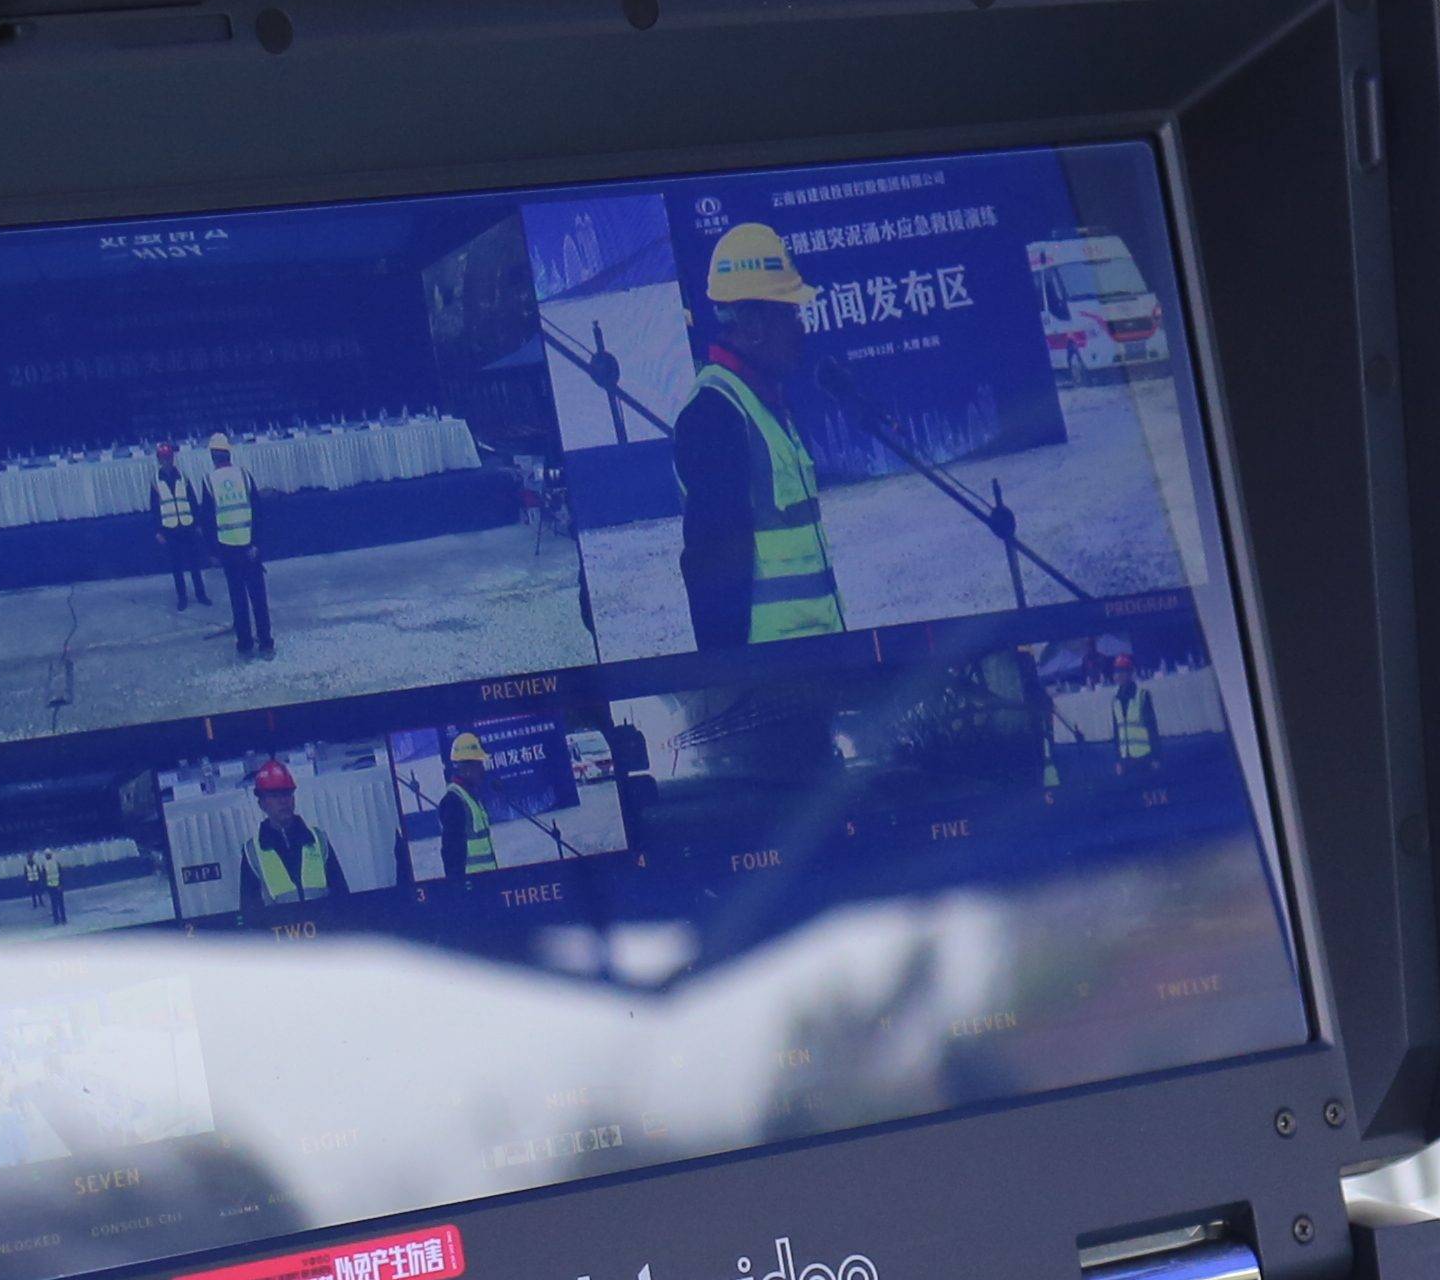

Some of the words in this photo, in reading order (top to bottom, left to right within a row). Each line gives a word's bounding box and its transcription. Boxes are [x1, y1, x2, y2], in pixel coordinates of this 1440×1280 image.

[797, 264, 974, 335] 新闻发布区
[1105, 596, 1178, 617] PROGRAM
[481, 676, 557, 701] PREVIEW
[845, 822, 855, 836] 5
[932, 819, 970, 839] FIVE
[637, 854, 647, 869] 4
[732, 848, 781, 872] FOUR
[416, 888, 427, 903] 3
[502, 881, 564, 909] THREE
[186, 924, 196, 939] 2
[272, 921, 318, 943] TWO
[73, 1168, 141, 1195] SEVEN
